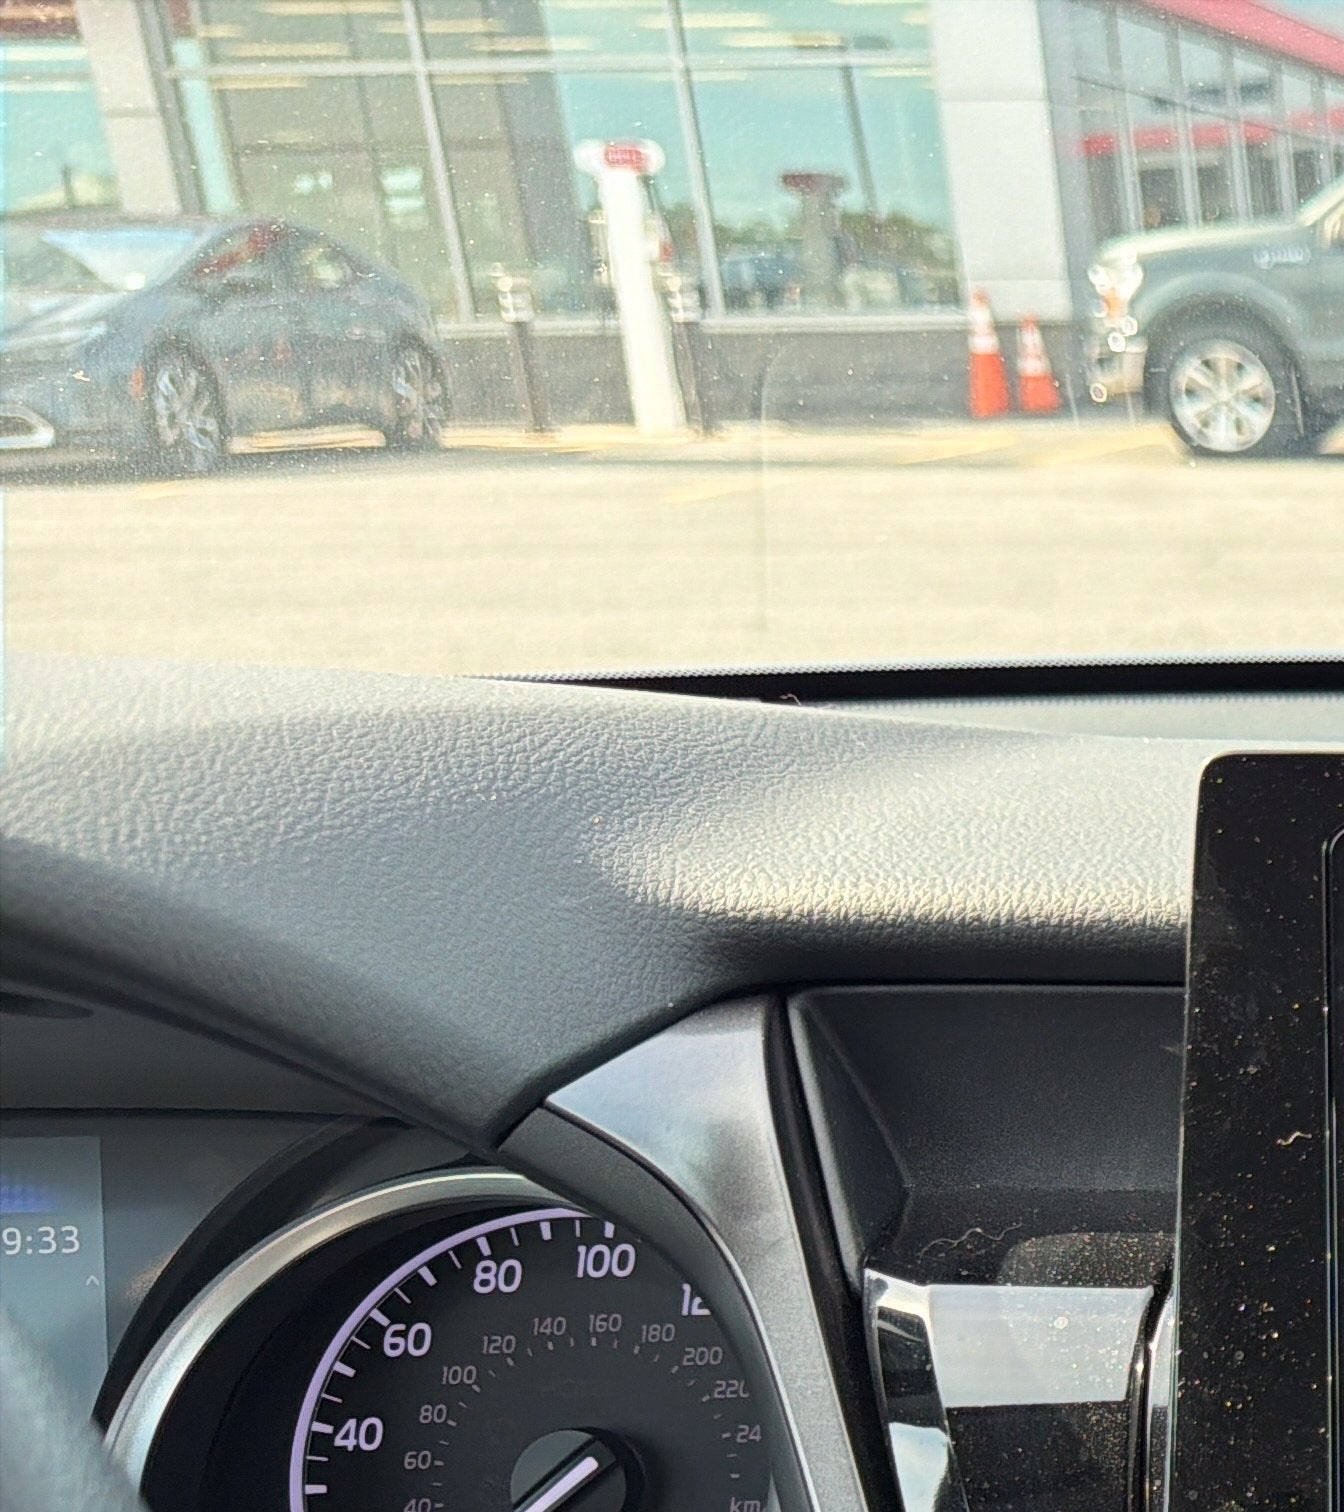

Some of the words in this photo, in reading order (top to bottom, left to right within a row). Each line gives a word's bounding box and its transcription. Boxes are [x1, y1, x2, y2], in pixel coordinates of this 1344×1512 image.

[2, 1225, 81, 1256] 9:33
[576, 1243, 635, 1279] 100
[472, 1258, 523, 1294] 80
[531, 1316, 568, 1337] 140
[588, 1313, 622, 1333] 160
[641, 1323, 676, 1343] 180
[382, 1323, 432, 1358] 60
[481, 1333, 517, 1355] 120
[682, 1346, 724, 1367] 200
[441, 1364, 478, 1386] 100
[419, 1403, 448, 1425] 80
[333, 1418, 385, 1453] 40
[403, 1450, 433, 1471] 60
